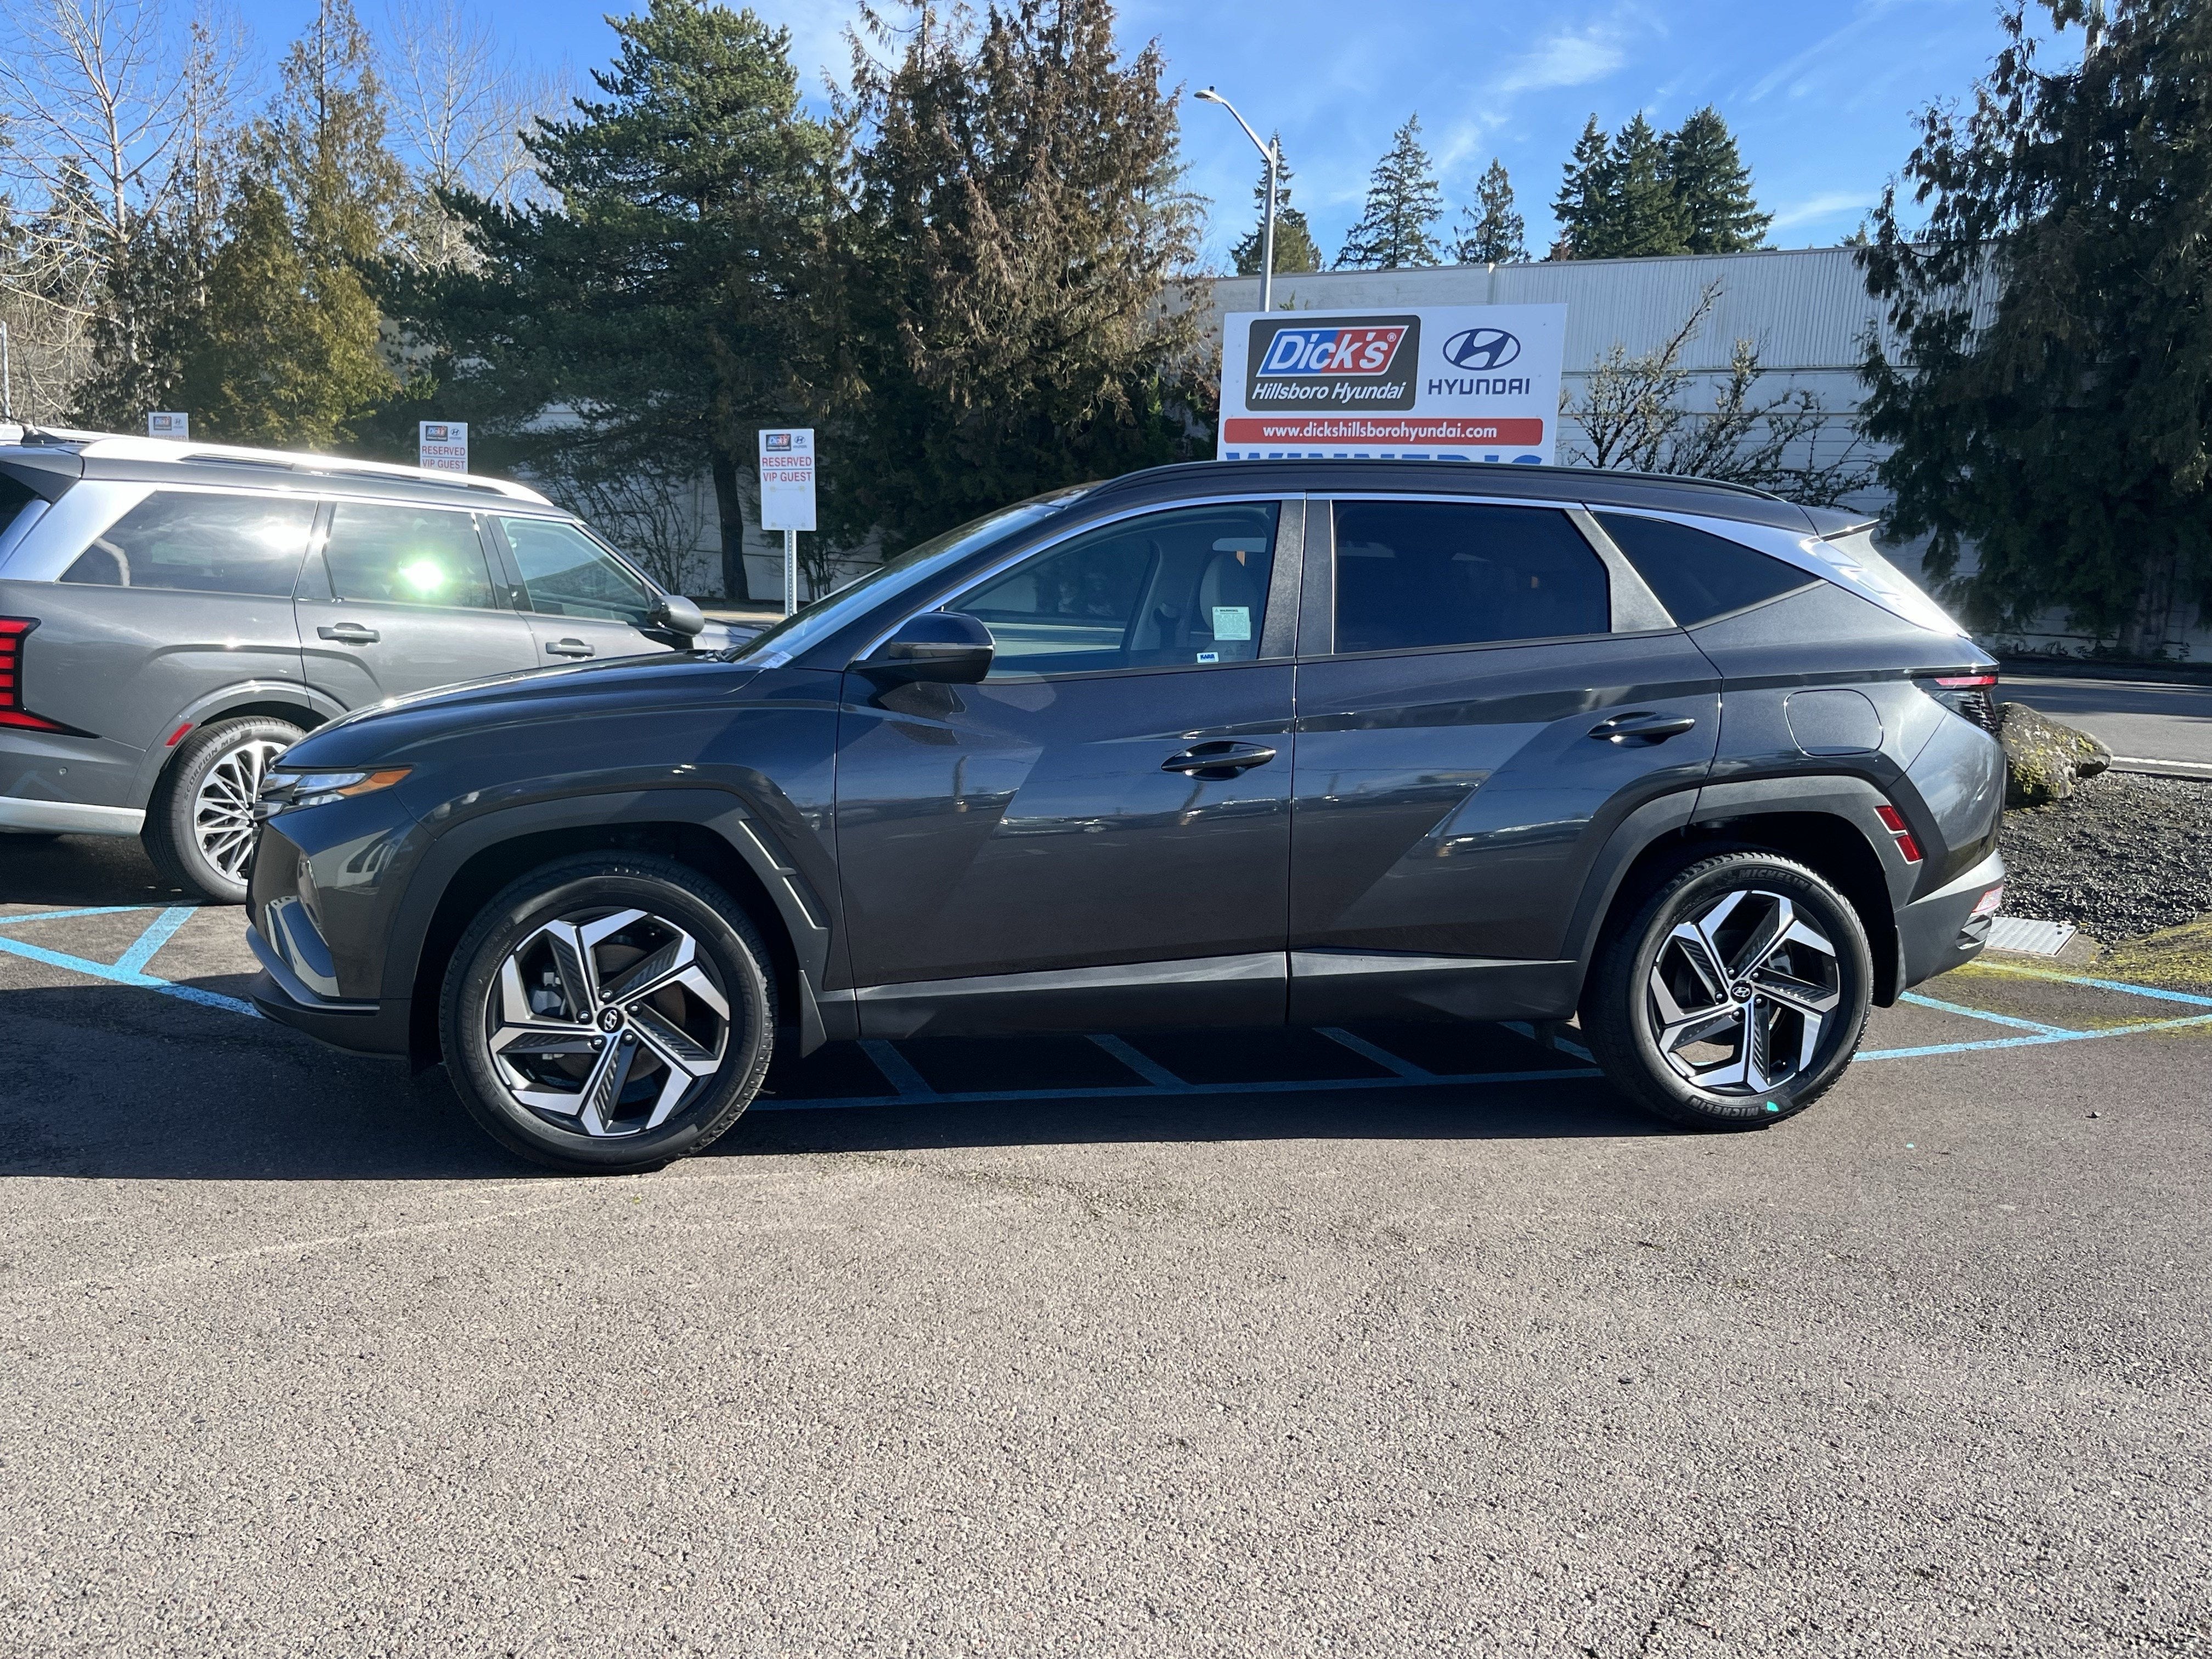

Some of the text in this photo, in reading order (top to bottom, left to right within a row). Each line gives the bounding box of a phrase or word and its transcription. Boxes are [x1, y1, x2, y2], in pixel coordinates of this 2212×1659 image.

[1268, 332, 1389, 370] Dick's
[1251, 382, 1407, 404] Hillsboro Hyundai
[1428, 379, 1530, 395] HYUNDAI
[1263, 422, 1497, 441] www.dickshillsborohyundai.com
[422, 446, 466, 456] RESERVED
[422, 459, 466, 470] VIP GUEST
[761, 456, 812, 467] RESERVED
[763, 472, 812, 482] VIP GUEST
[184, 747, 218, 800] SCORPION
[1739, 868, 1809, 890] MICHELIN
[1689, 1097, 1759, 1118] MICHELIN
